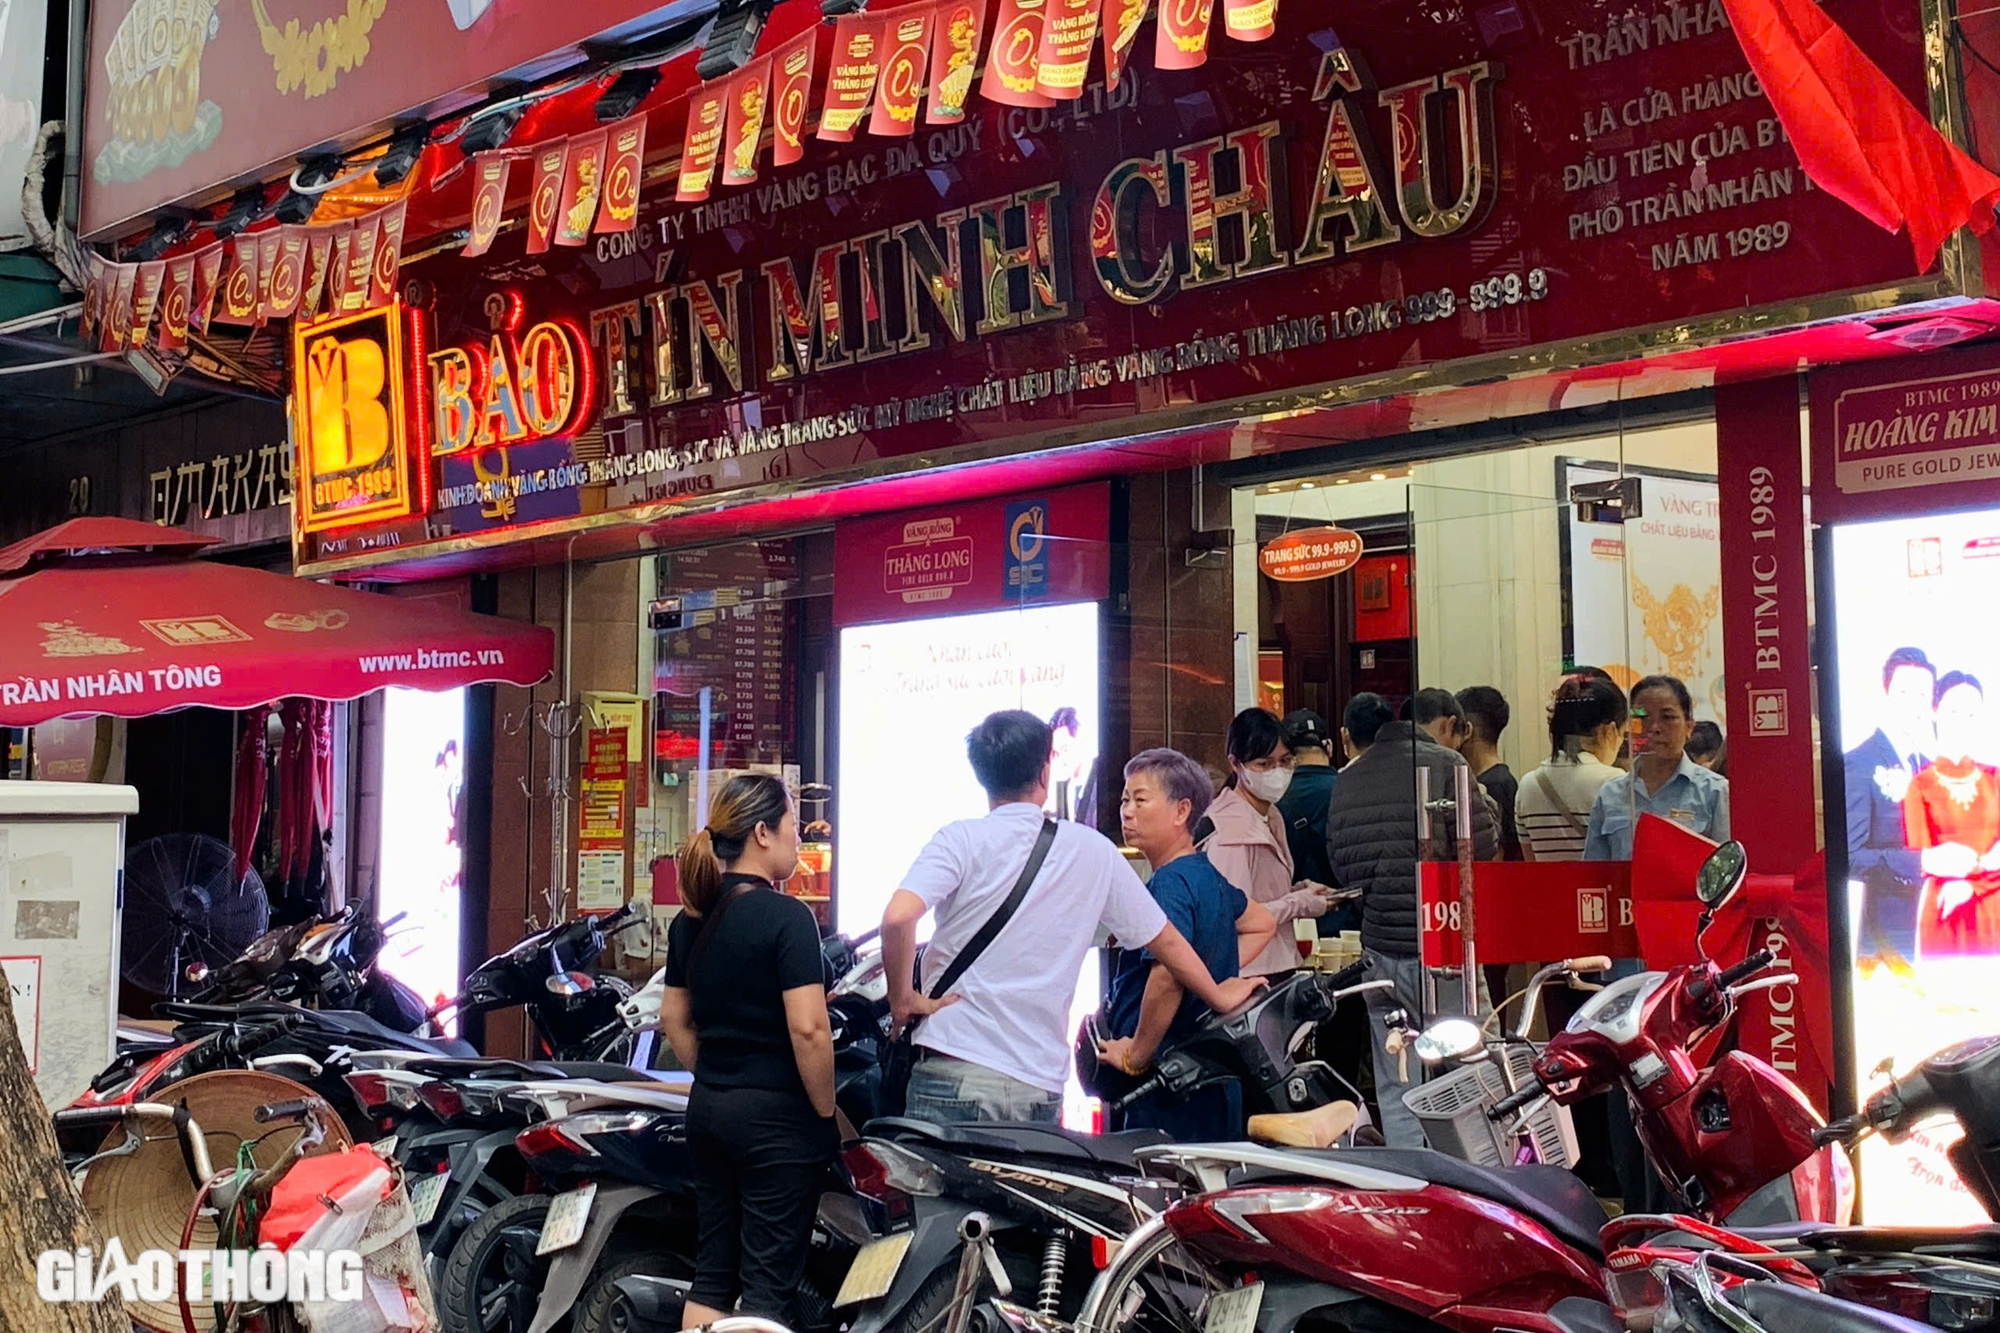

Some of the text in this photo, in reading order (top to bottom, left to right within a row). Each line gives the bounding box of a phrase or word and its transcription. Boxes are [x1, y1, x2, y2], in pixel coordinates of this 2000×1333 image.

[1584, 71, 1763, 139] LÀ CỬA HÀNG
[1562, 150, 1618, 192] ĐẦU
[1690, 121, 1750, 163] CỦA
[657, 211, 685, 244] TY
[692, 192, 751, 234] TNHH
[756, 172, 821, 214] VÀNG
[827, 152, 879, 199] BẠC
[928, 114, 984, 163] QUÝ
[1568, 197, 1625, 241] PHỐ
[1625, 182, 1703, 227] TRẦN
[1705, 168, 1794, 212] NHÂN
[428, 47, 1490, 457] BẢO TÍN MINH CHÂU
[1651, 220, 1791, 272] NĂM 1989
[781, 414, 838, 447] TRANG
[1242, 313, 1327, 356] THĂNG
[1331, 299, 1402, 339] LONG
[1905, 380, 2000, 408] BTMC 1989
[1844, 403, 1998, 453] HOÀNG KIM
[1863, 462, 1906, 482] PURE
[1912, 456, 1962, 476] GOLD
[314, 468, 393, 505] BTMC 1989
[1660, 495, 1702, 516] VÀNG
[906, 520, 952, 538] VÀNG RỒNG
[1640, 521, 1716, 541] CHẤT LIỆU BẰNG
[886, 548, 970, 576] THĂNG LONG
[1264, 549, 1293, 564] TRANG
[1293, 544, 1311, 561] SỨC
[1305, 562, 1321, 571] GOLD
[1321, 558, 1347, 570] JEWELRY
[1749, 466, 1781, 672] BTMC 1989
[358, 648, 505, 674] www.btmc.vn
[0, 664, 222, 706] RẦN NHÂN TÔNG
[1422, 900, 1462, 932] 198
[968, 1160, 1069, 1194] BLADE
[1609, 1252, 1642, 1269] YAMAHA
